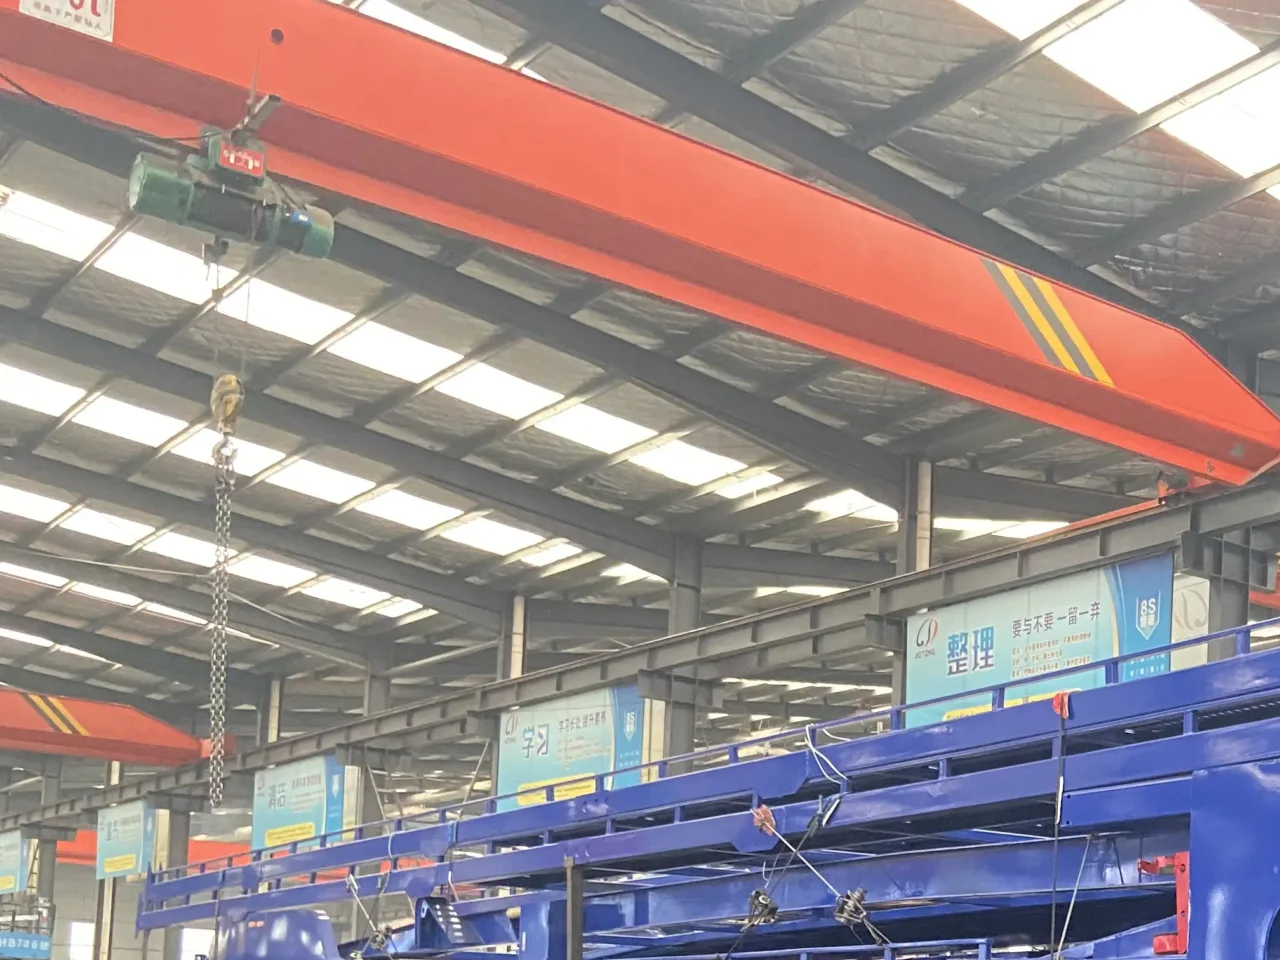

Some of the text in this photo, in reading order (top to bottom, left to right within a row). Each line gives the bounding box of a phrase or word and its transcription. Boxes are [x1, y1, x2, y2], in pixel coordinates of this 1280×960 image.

[1141, 598, 1156, 616] 8S
[1012, 612, 1054, 639] 要与不要
[947, 625, 995, 676] 整理
[522, 723, 549, 758] 学习
